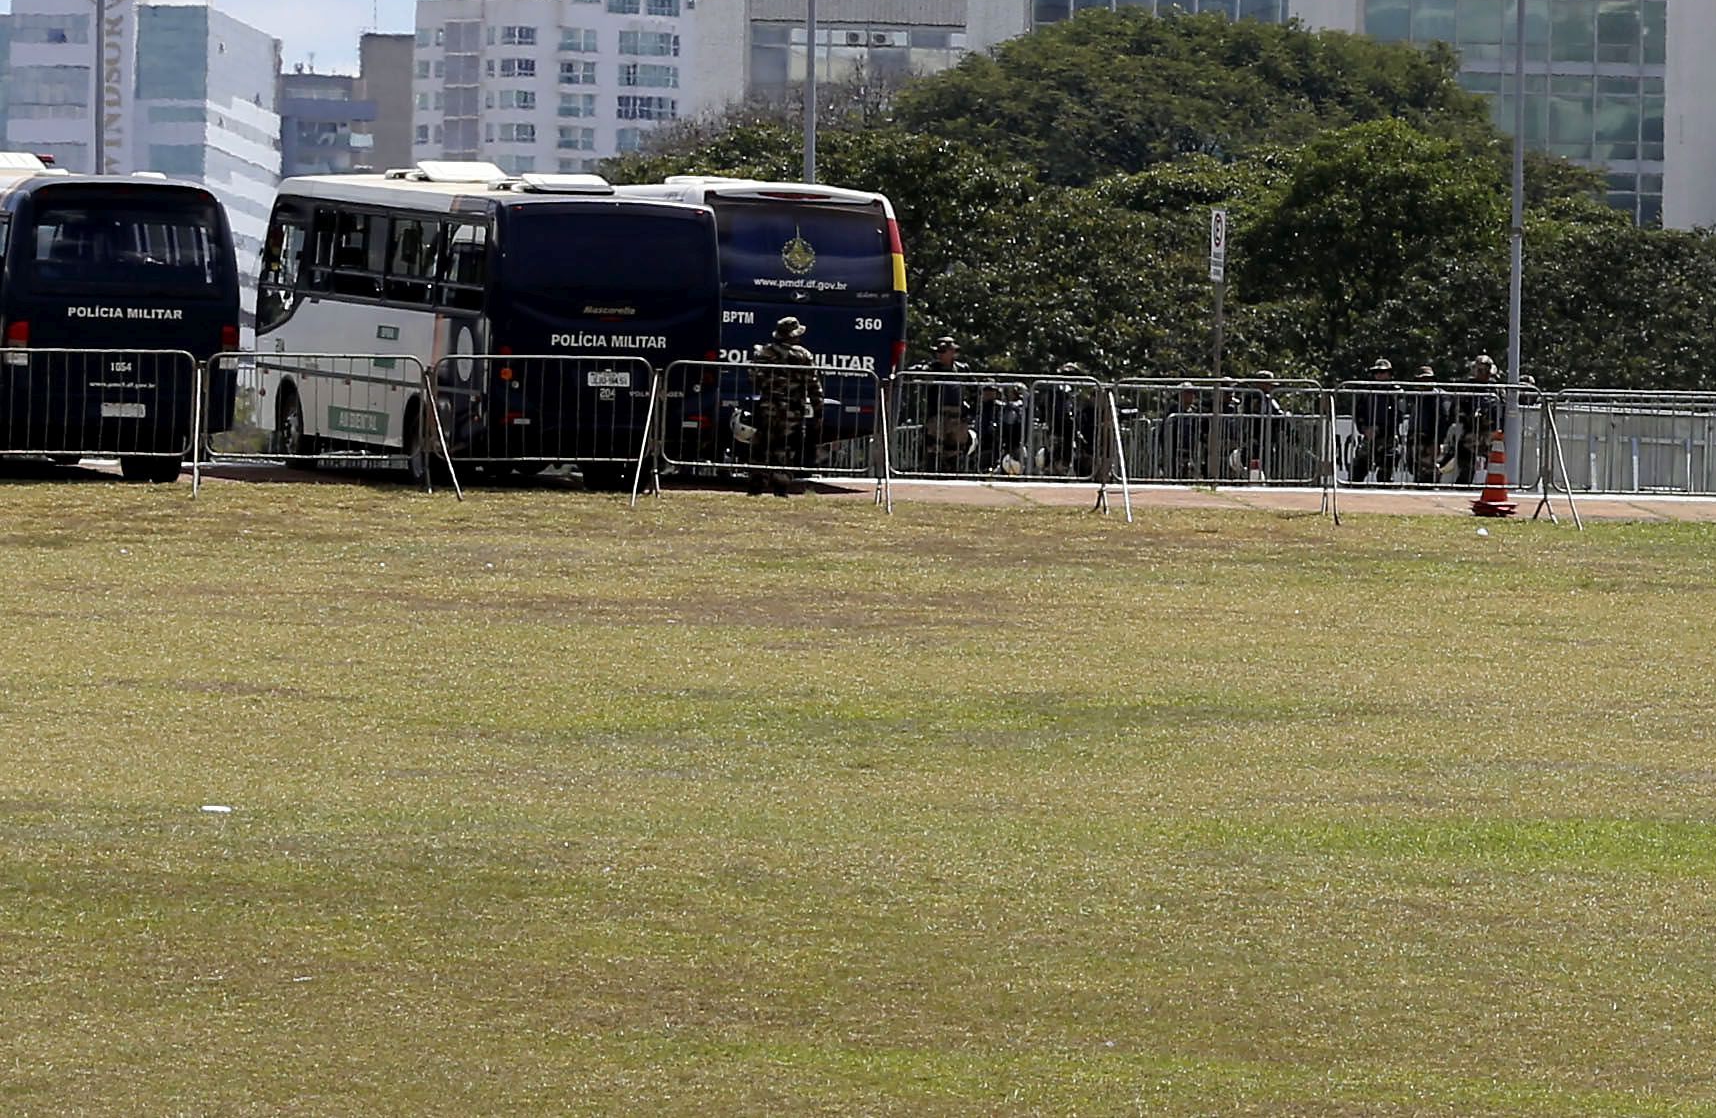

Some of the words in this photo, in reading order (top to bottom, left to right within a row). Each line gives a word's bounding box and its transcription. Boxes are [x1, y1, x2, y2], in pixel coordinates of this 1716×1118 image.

[754, 278, 847, 291] www.pmdf.df.gov.br
[68, 305, 123, 318] POLÍCIA
[127, 308, 183, 320] MILITAR
[855, 318, 882, 331] 360
[551, 331, 607, 347] POLÍCIA
[611, 334, 667, 349] MILITAR
[814, 353, 875, 370] ILITAR
[600, 388, 616, 398] 204
